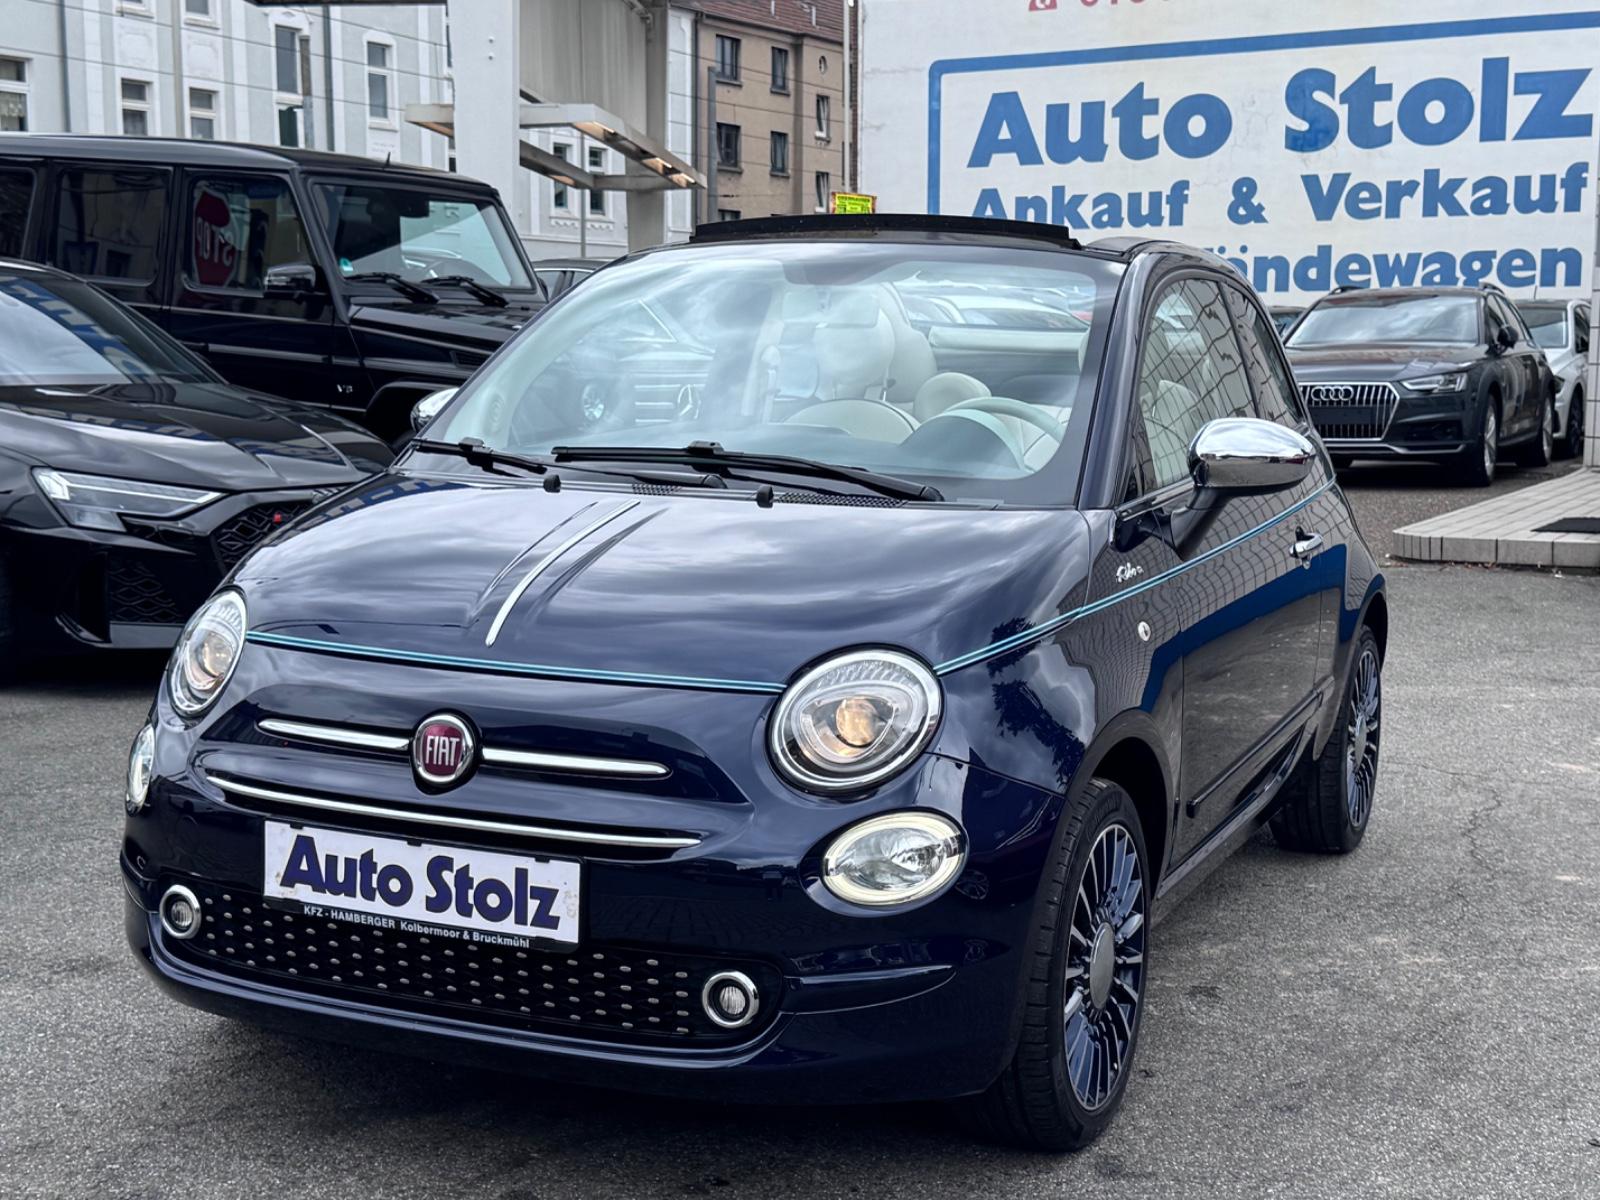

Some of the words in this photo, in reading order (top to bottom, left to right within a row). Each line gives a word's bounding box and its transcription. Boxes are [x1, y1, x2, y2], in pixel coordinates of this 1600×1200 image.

[967, 81, 1233, 168] Auto
[1284, 57, 1593, 153] Stolz
[971, 179, 1191, 230] Ankauf
[1226, 176, 1268, 224] &
[1300, 161, 1590, 222] Verkauf
[426, 735, 460, 766] FIAT
[279, 834, 414, 907] Auto
[425, 855, 560, 930] Stolz
[303, 904, 324, 917] KFZ
[331, 909, 396, 929] HAMBERGER
[400, 920, 461, 939] Kolbermoor
[462, 930, 471, 941] &
[472, 931, 530, 949] Bruckmühl
